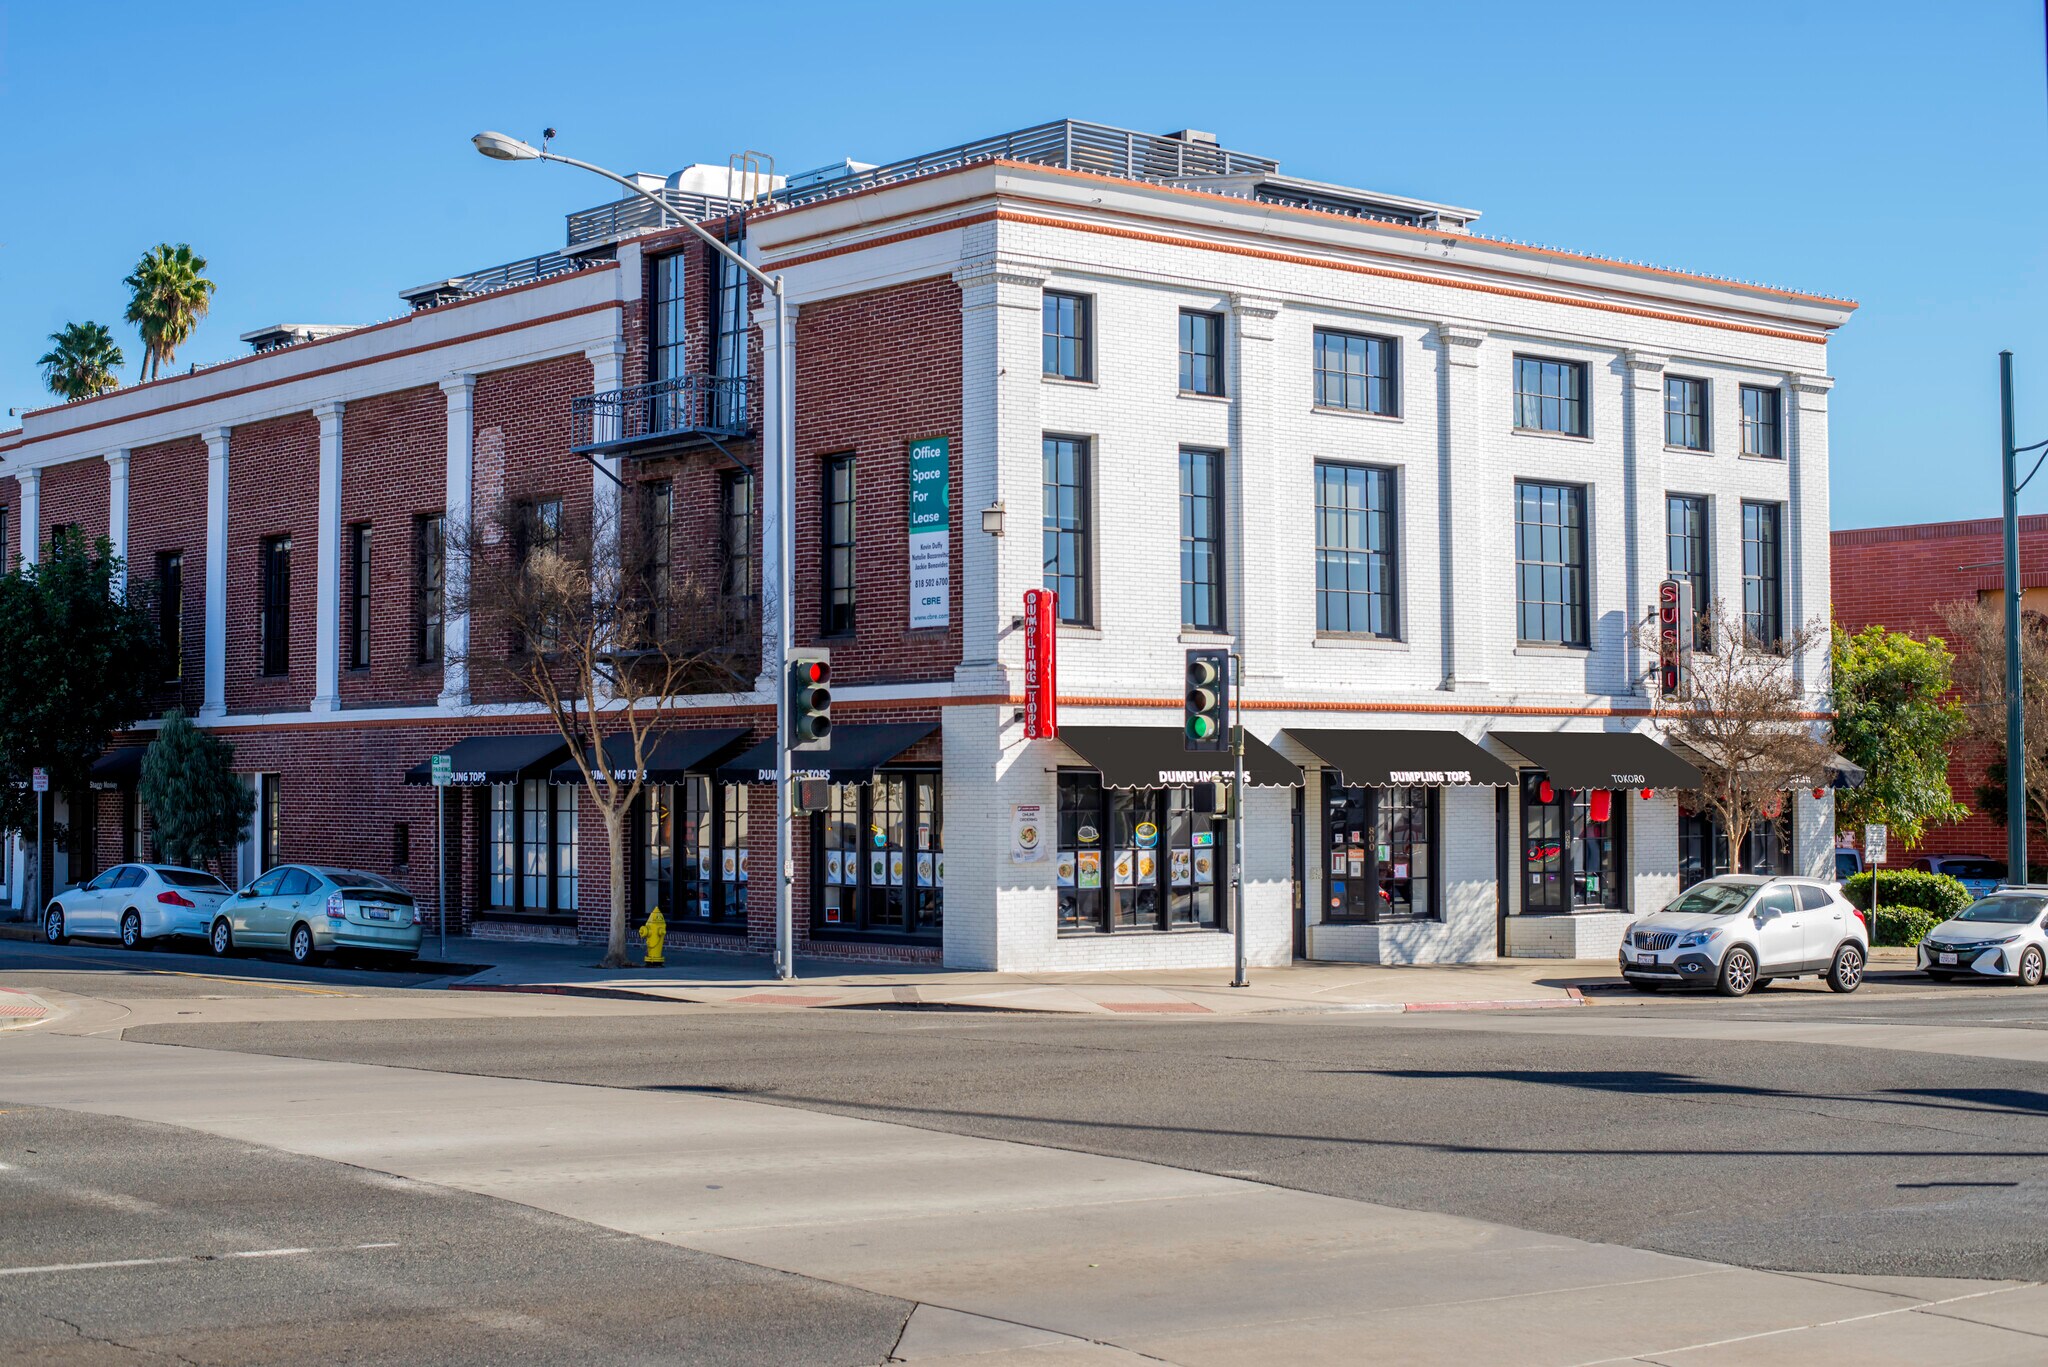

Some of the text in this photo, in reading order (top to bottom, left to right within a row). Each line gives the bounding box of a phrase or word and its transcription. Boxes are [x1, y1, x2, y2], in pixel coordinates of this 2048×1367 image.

[913, 446, 941, 460] Office
[912, 469, 941, 484] Space
[913, 490, 929, 503] For
[913, 512, 940, 524] Lease
[914, 577, 948, 588] 818 502 6700
[921, 596, 941, 606] CBRE
[1025, 592, 1038, 737] DUMPLING TOPS
[433, 756, 439, 764] 2
[469, 771, 486, 782] TOPS
[627, 769, 647, 780] TOS
[1158, 771, 1220, 783] DUMPLING
[1390, 771, 1471, 782] DUMPLING TOPS
[1611, 774, 1645, 783] TOKORO
